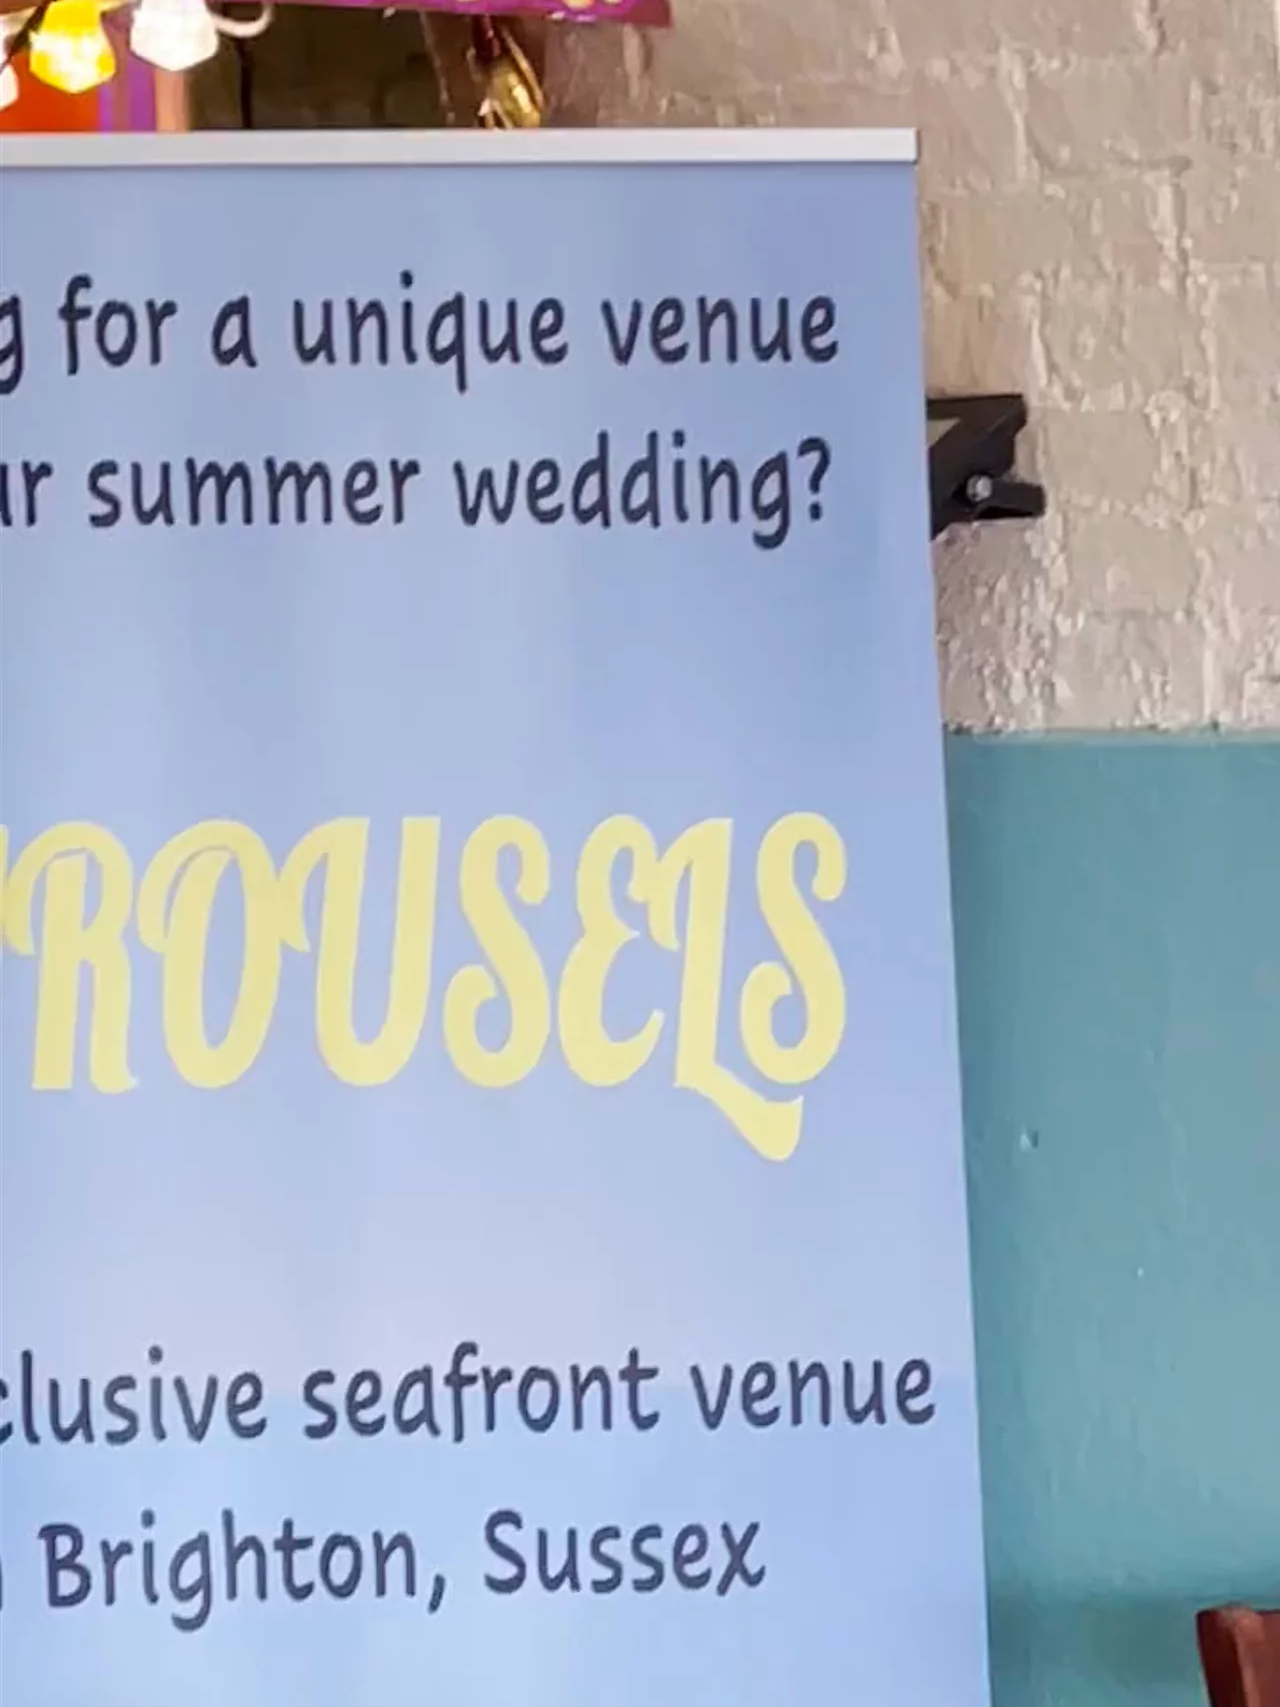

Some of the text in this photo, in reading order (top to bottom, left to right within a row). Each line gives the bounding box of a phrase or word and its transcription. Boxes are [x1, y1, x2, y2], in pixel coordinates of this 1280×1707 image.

[58, 273, 178, 376] for
[211, 295, 258, 369] a
[293, 269, 569, 394] unique
[600, 294, 839, 367] venue
[87, 455, 421, 528] summer
[453, 428, 831, 551] wedding?
[0, 812, 847, 1161] ROUSELS
[303, 1341, 660, 1443] seafront
[690, 1355, 936, 1430] venue
[38, 1508, 446, 1632] Brighton,
[484, 1509, 766, 1597] Sussex
